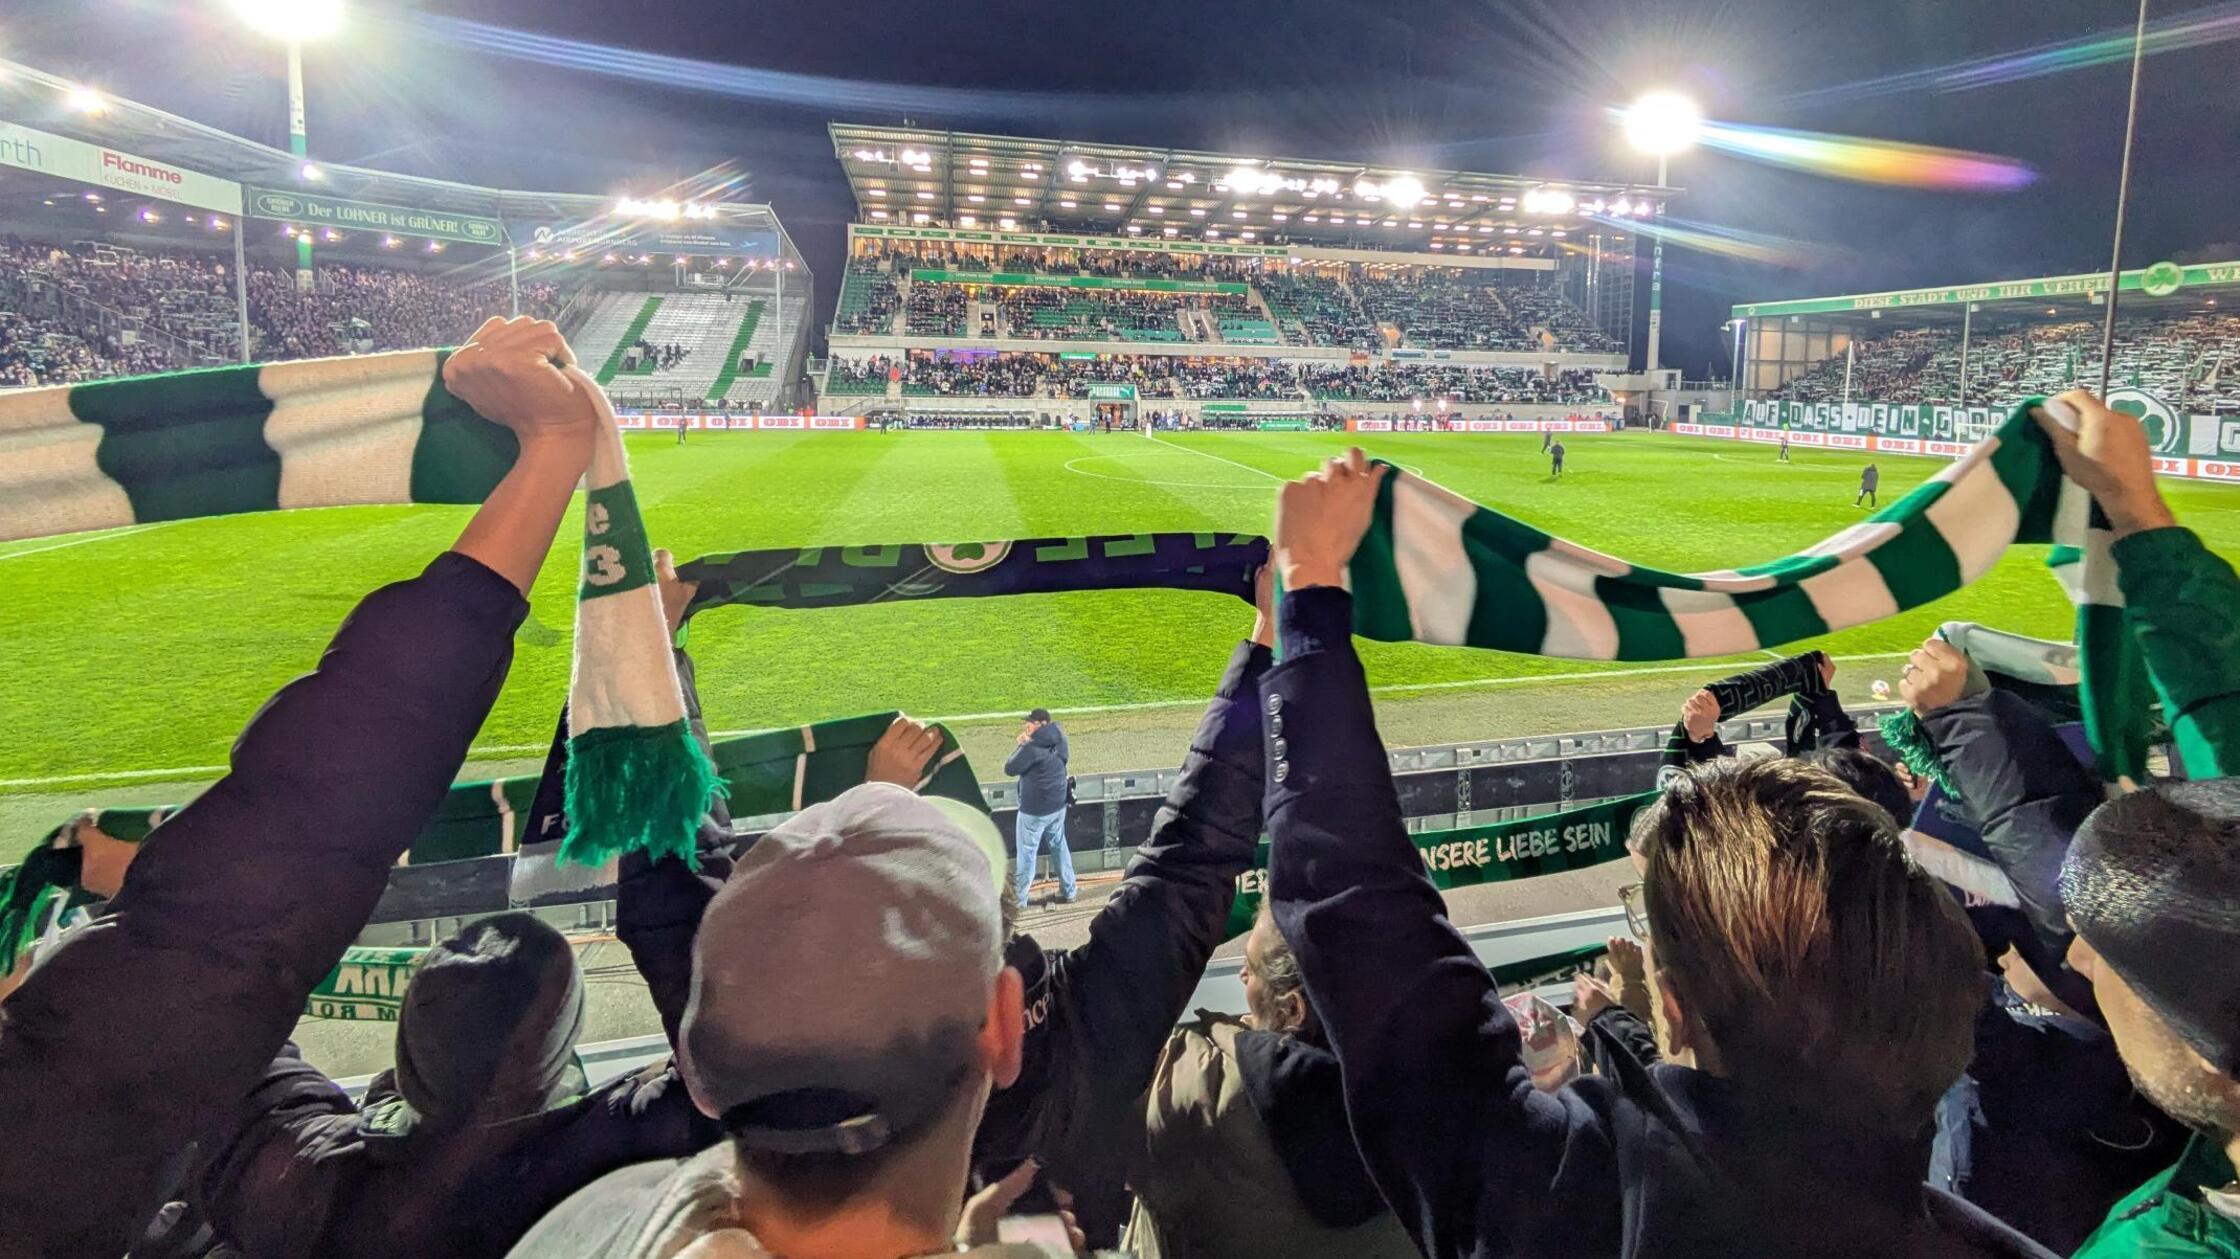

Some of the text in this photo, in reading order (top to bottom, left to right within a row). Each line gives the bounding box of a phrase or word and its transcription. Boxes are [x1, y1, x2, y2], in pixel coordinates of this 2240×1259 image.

[103, 151, 182, 184] Flamme
[308, 203, 458, 233] Der LOHNER ist GRÜNER!
[1854, 296, 1893, 309] DIESE
[1899, 291, 1949, 306] STADT
[1956, 288, 1990, 301] UND
[1999, 284, 2032, 297] IHR
[763, 417, 799, 427] OBI
[814, 417, 850, 427] OBI
[1743, 400, 1779, 427] AUF
[1790, 402, 1842, 430] DASS
[1857, 403, 1919, 436] DEIN
[2151, 458, 2180, 472] BI
[2205, 463, 2240, 477] OB
[1419, 837, 1492, 872] NSERE
[1496, 828, 1561, 862] LIEBE
[1563, 822, 1611, 853] SEIN
